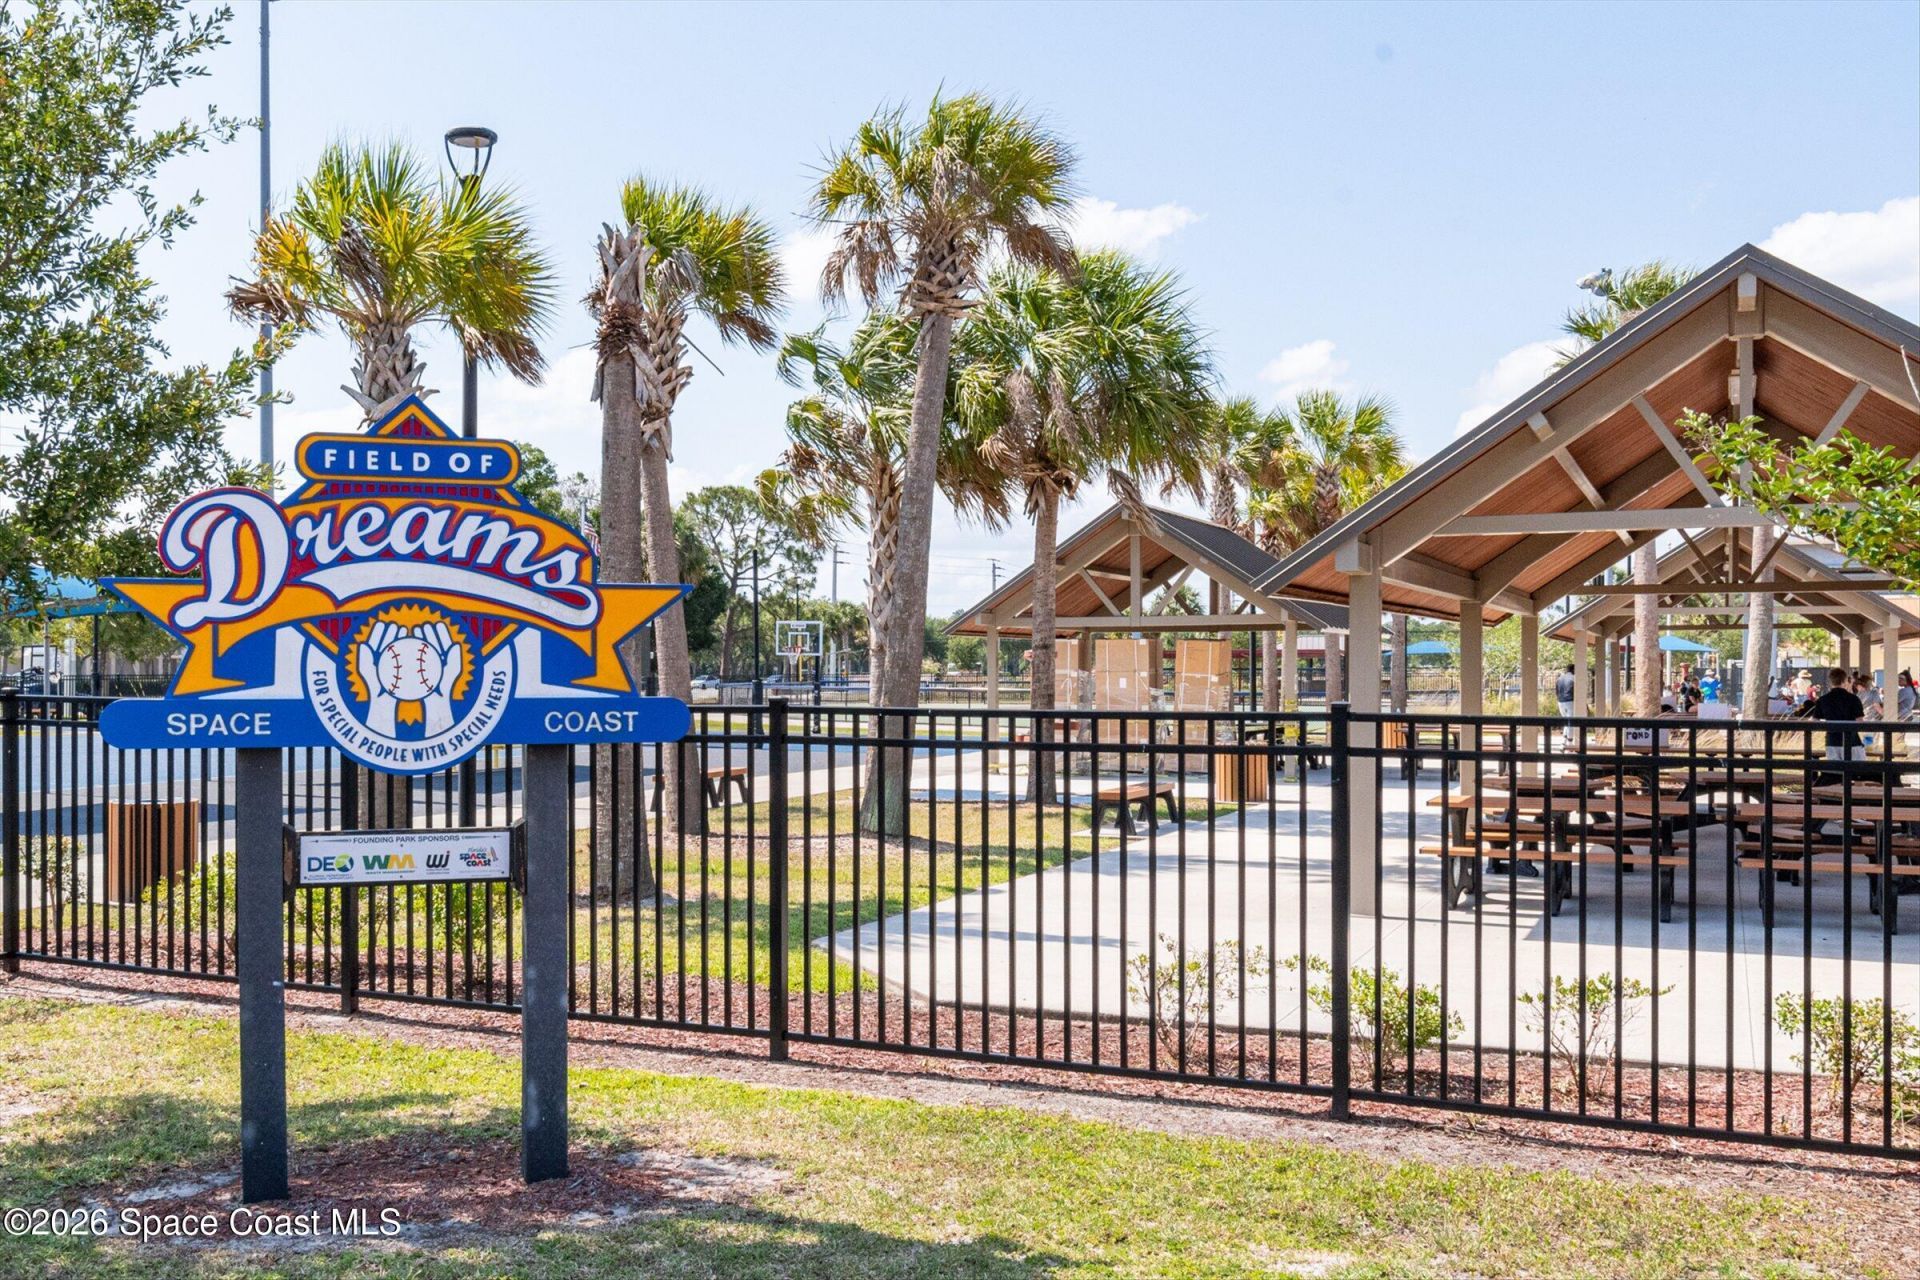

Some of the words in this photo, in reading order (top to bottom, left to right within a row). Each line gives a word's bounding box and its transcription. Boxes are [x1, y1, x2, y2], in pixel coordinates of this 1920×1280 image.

[323, 448, 431, 472] FIELD
[448, 452, 493, 474] OF
[164, 491, 600, 628] Dreams
[312, 669, 330, 697] FOR
[485, 669, 507, 711] NEEDS
[166, 712, 272, 737] SPACE
[544, 710, 639, 733] COAST
[319, 697, 361, 744] SPECIAL
[448, 711, 493, 751] SPECIAL
[358, 736, 408, 763] PEOPLE
[411, 742, 448, 762] WITH
[353, 836, 394, 844] FOUNDING
[395, 835, 416, 843] PARK
[417, 834, 460, 842] SPONSORS
